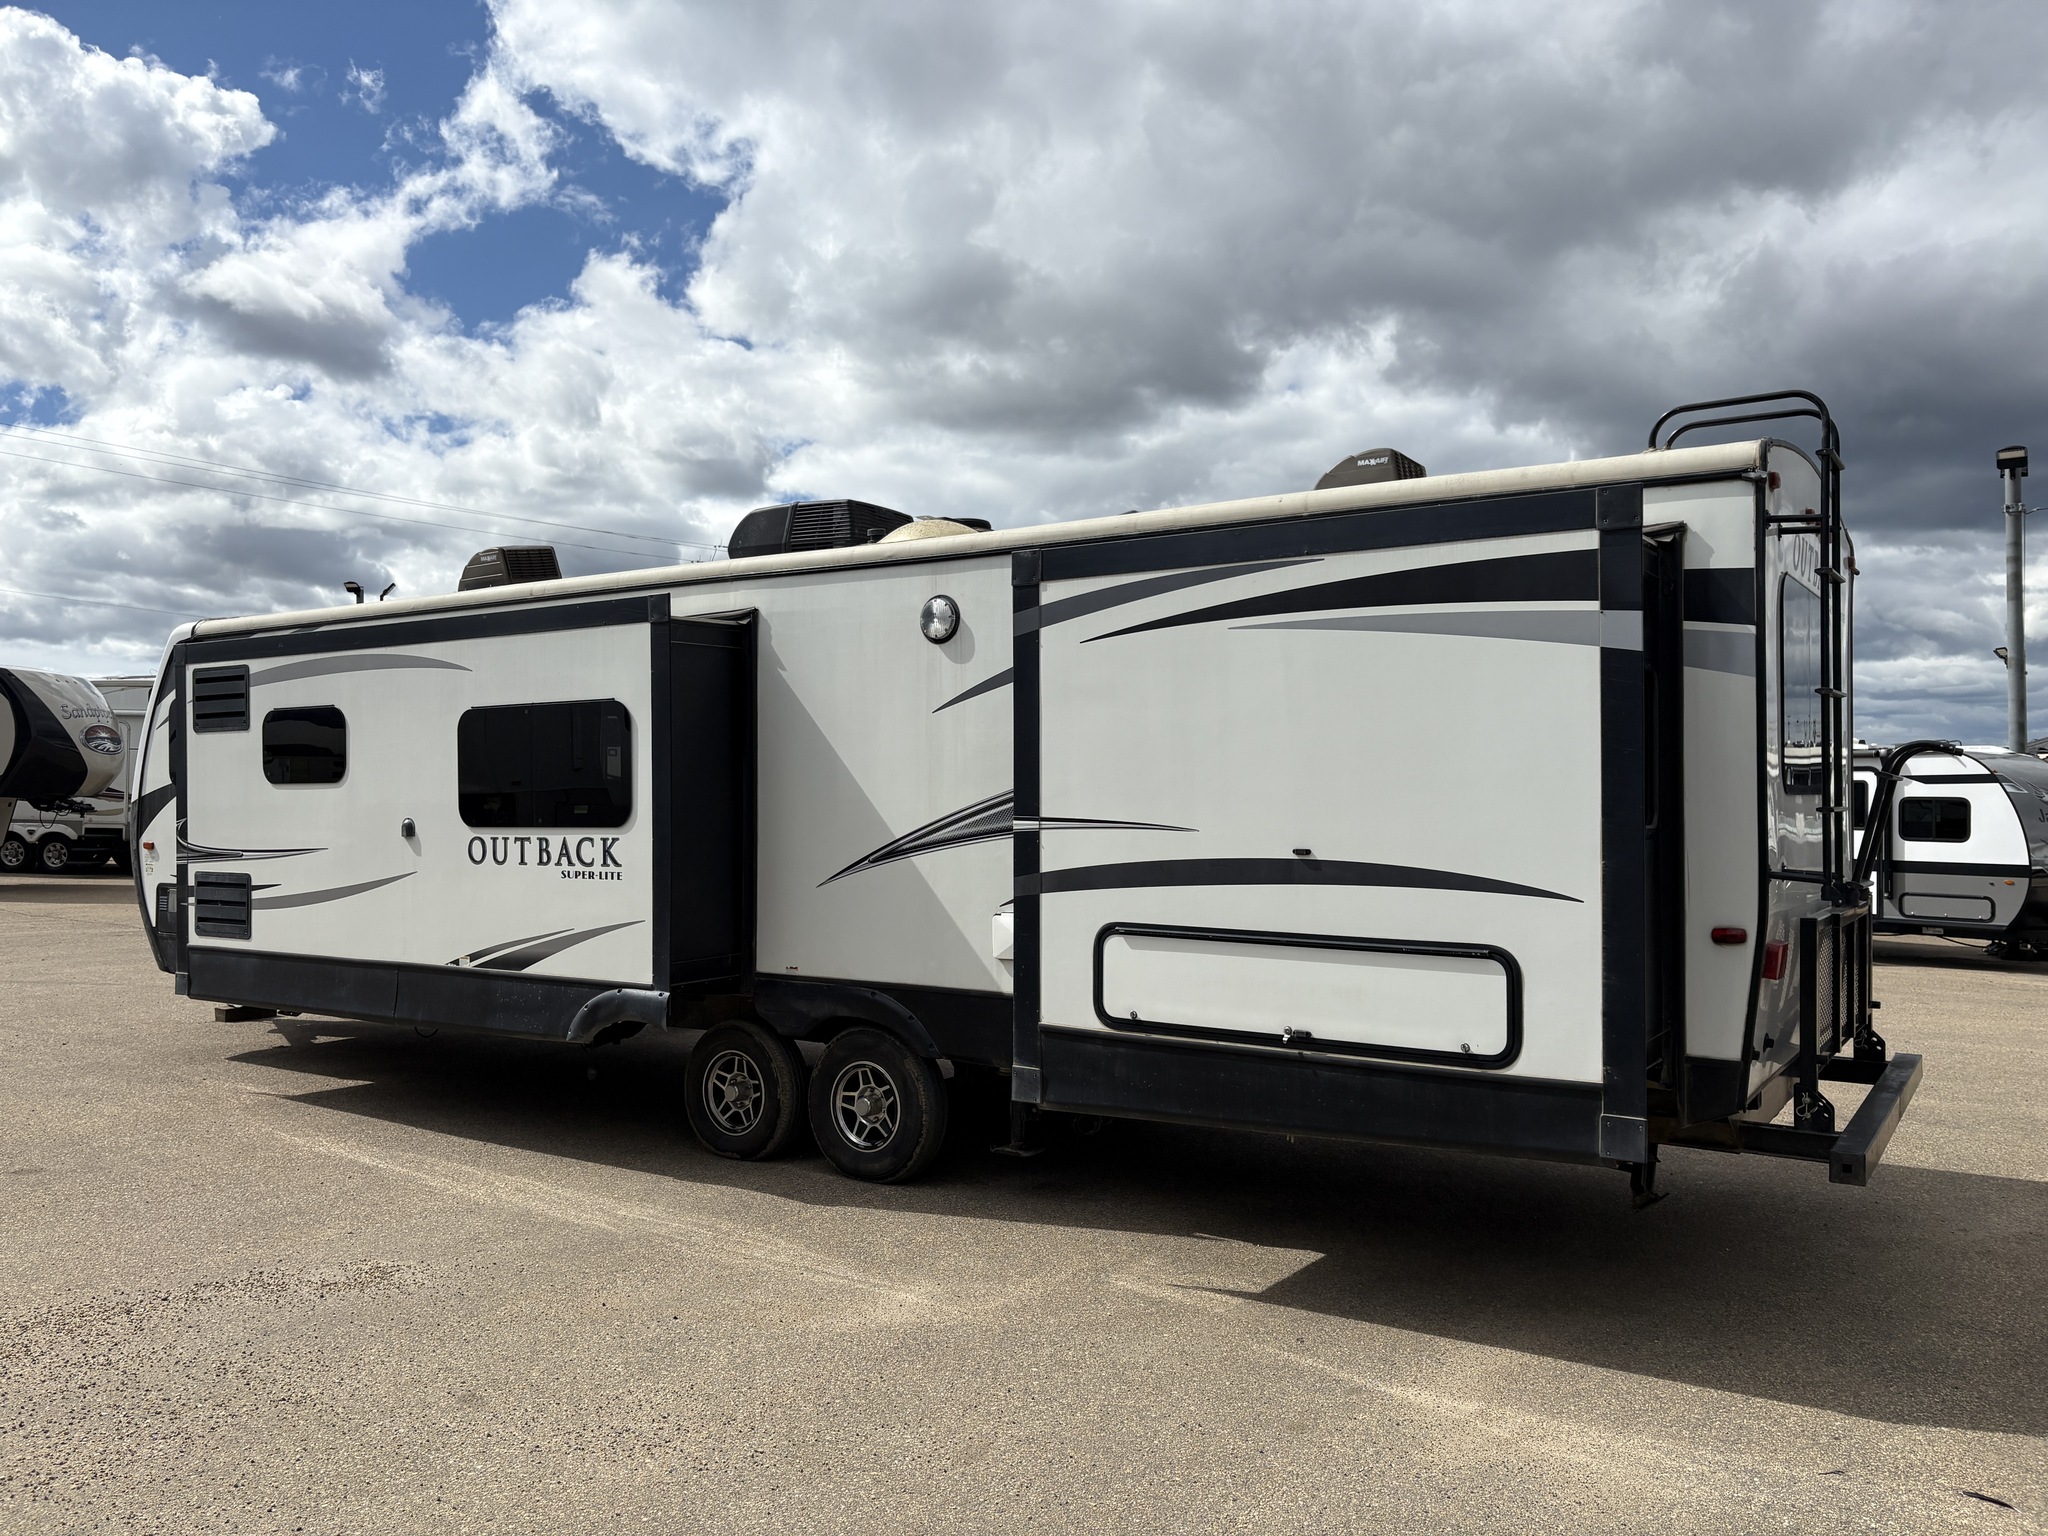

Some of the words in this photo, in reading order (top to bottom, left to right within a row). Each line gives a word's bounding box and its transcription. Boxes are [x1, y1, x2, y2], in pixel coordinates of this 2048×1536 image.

[1793, 533, 1821, 591] OUTB
[467, 836, 622, 868] OUTBACK
[561, 870, 623, 881] SUPER-LITE
